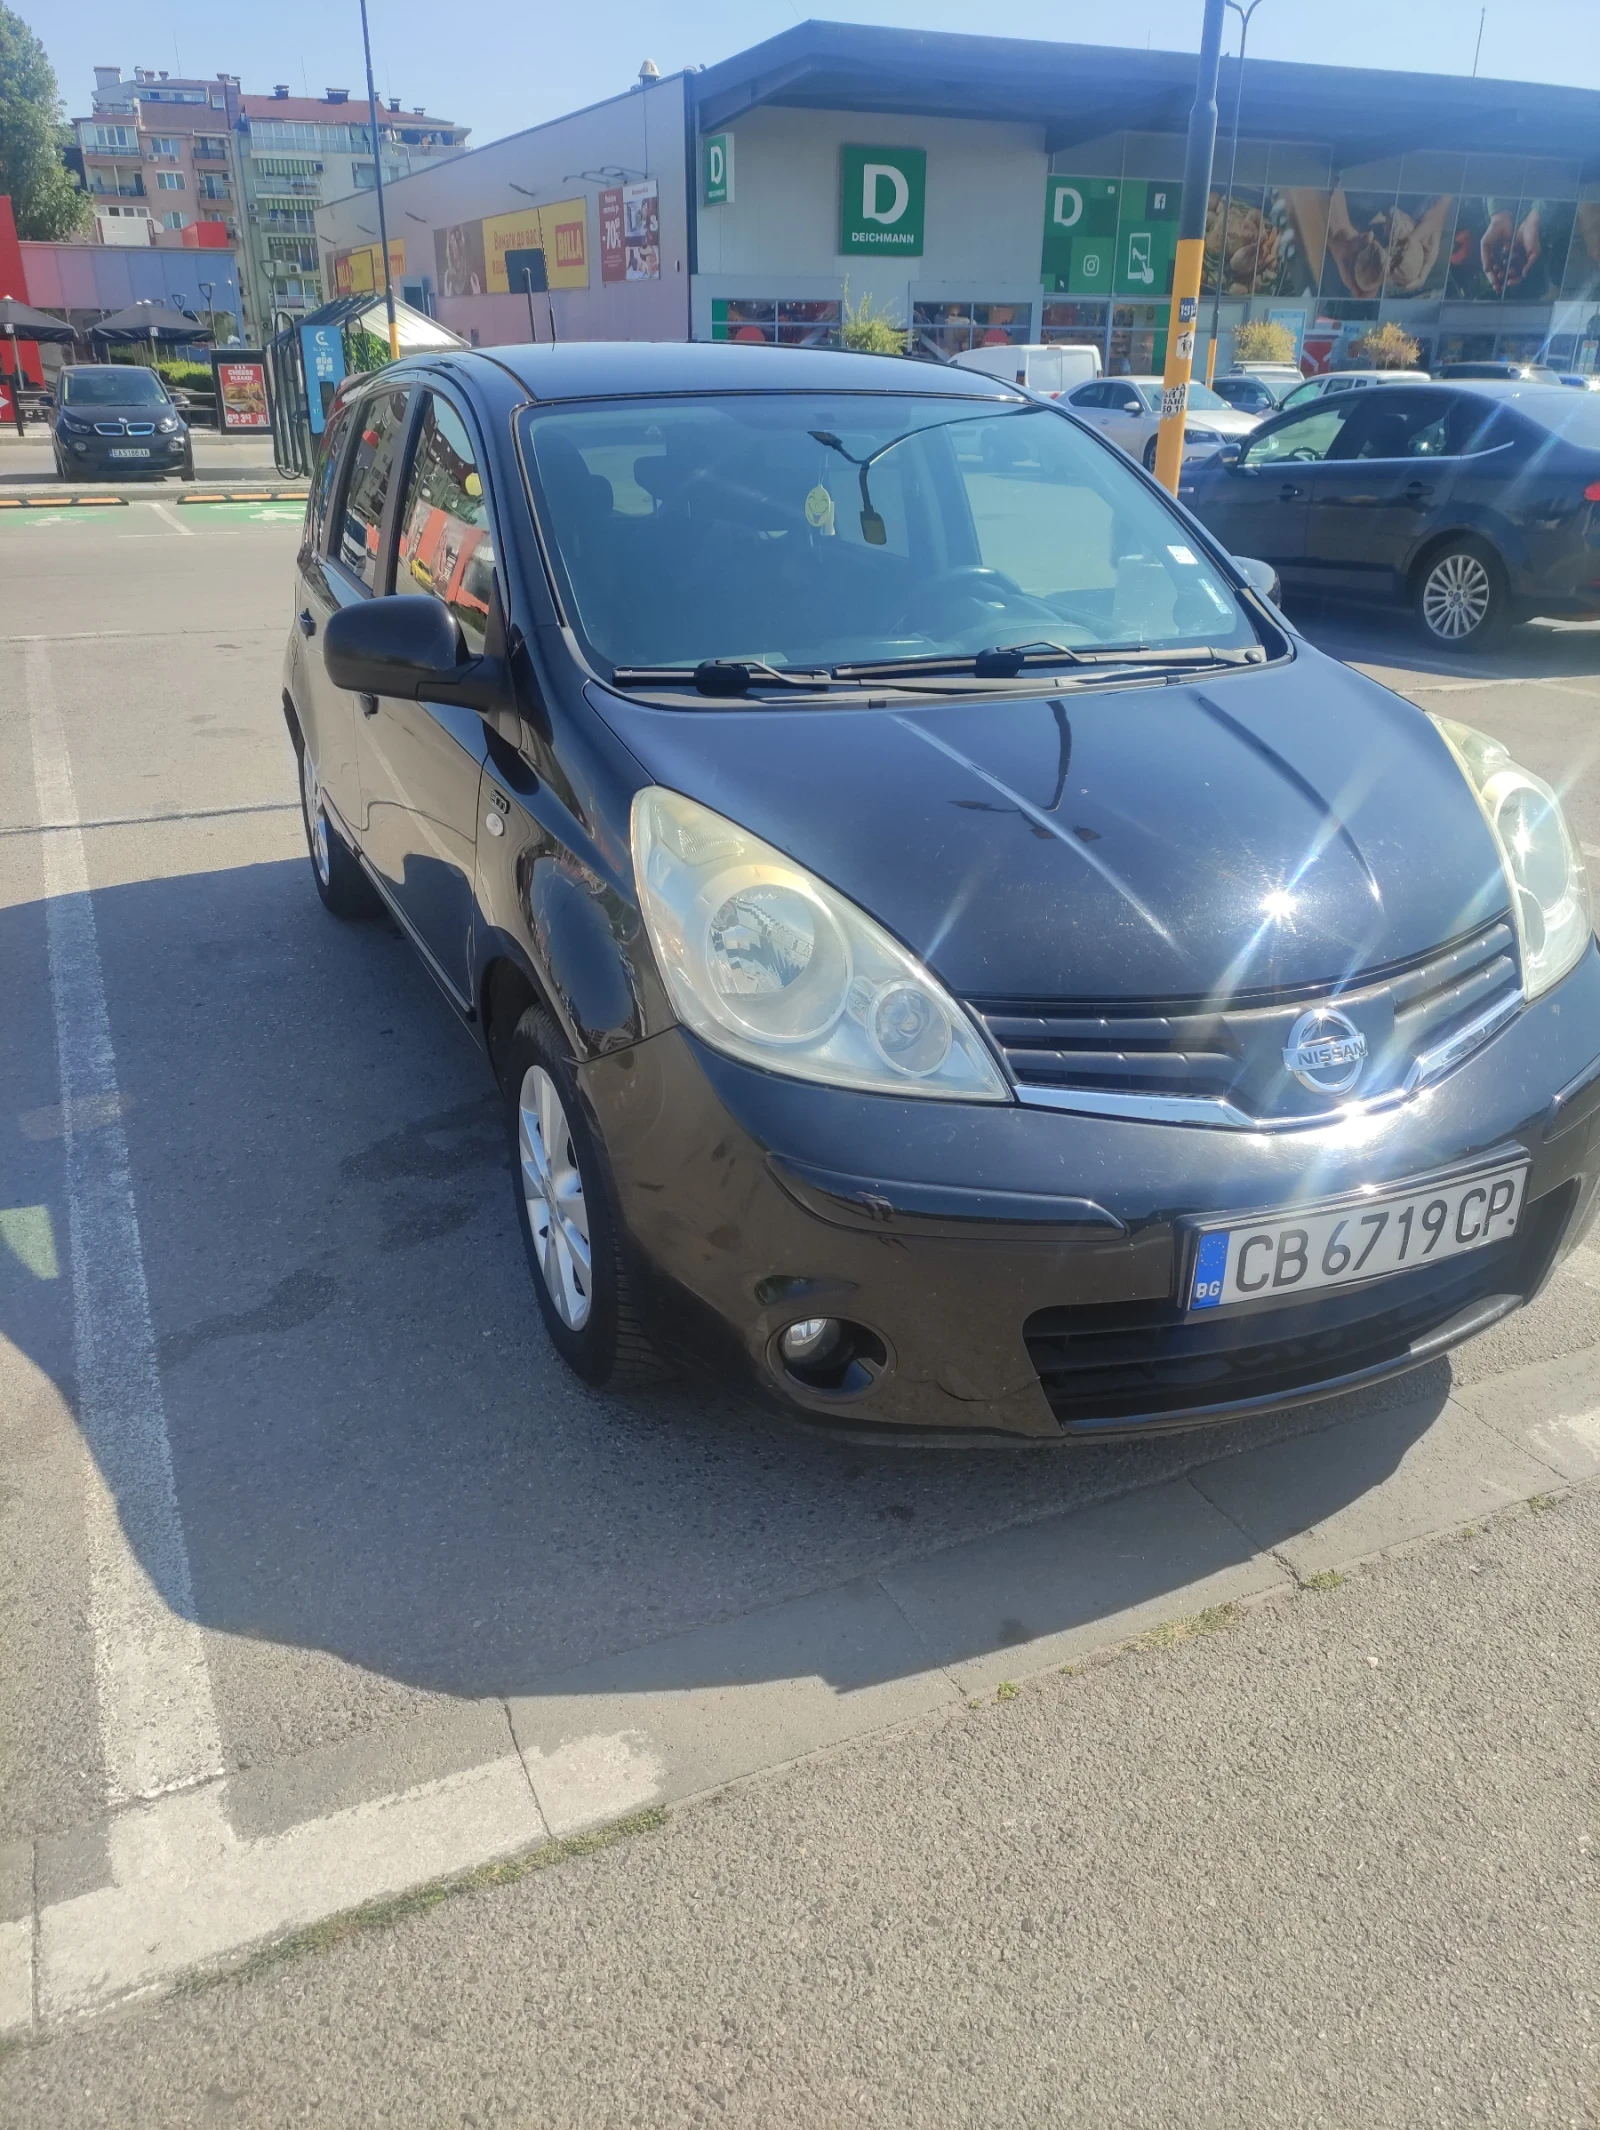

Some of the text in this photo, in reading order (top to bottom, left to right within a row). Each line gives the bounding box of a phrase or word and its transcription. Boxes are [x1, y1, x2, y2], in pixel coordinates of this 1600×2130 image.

[711, 145, 723, 184] D
[863, 164, 909, 224] D
[1053, 187, 1083, 226] D
[557, 229, 583, 261] BILLA
[852, 232, 914, 244] DEICHMANN
[1297, 1042, 1364, 1066] NISSAN
[1235, 1179, 1515, 1293] CB 6719 CP
[1195, 1280, 1220, 1299] BG
